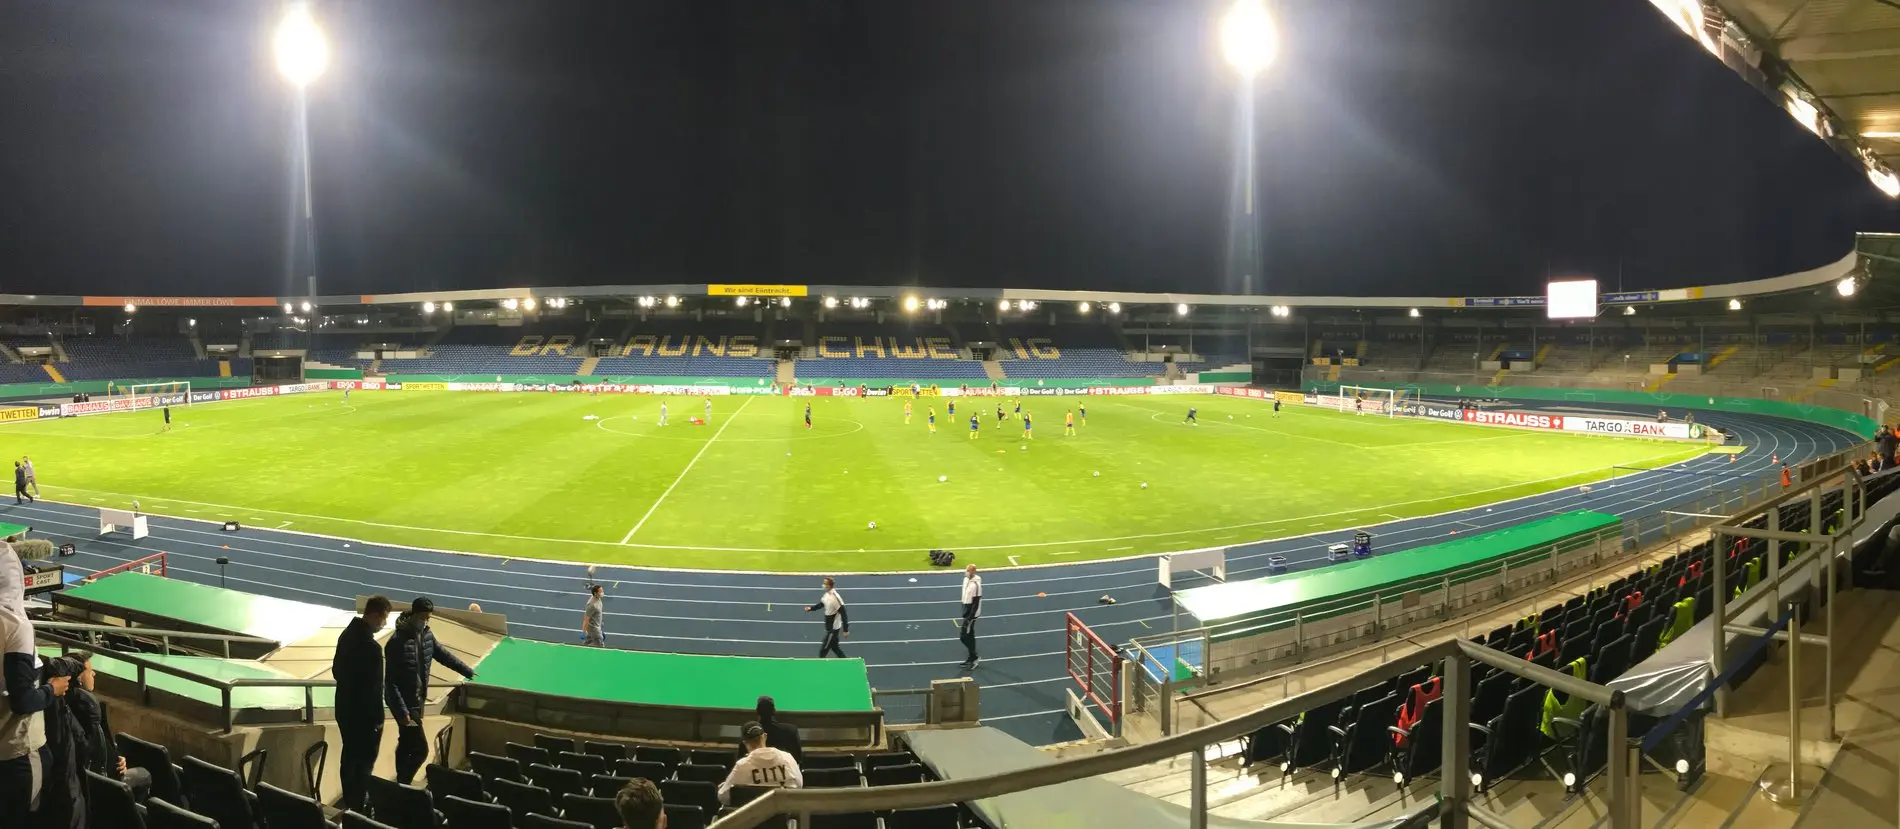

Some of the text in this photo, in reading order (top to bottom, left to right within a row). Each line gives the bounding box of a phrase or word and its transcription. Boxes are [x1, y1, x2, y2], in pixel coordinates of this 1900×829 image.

[510, 335, 1061, 359] BR AUNS CHWE IG
[203, 392, 213, 400] Golf
[230, 387, 273, 399] STRAUSS
[39, 406, 60, 416] bwin
[67, 401, 109, 414] BAUHAUS
[1428, 408, 1454, 418] Der Golf
[1475, 411, 1550, 428] STRAUSS
[1585, 420, 1666, 436] TARGO BANK
[751, 764, 787, 785] CITY
